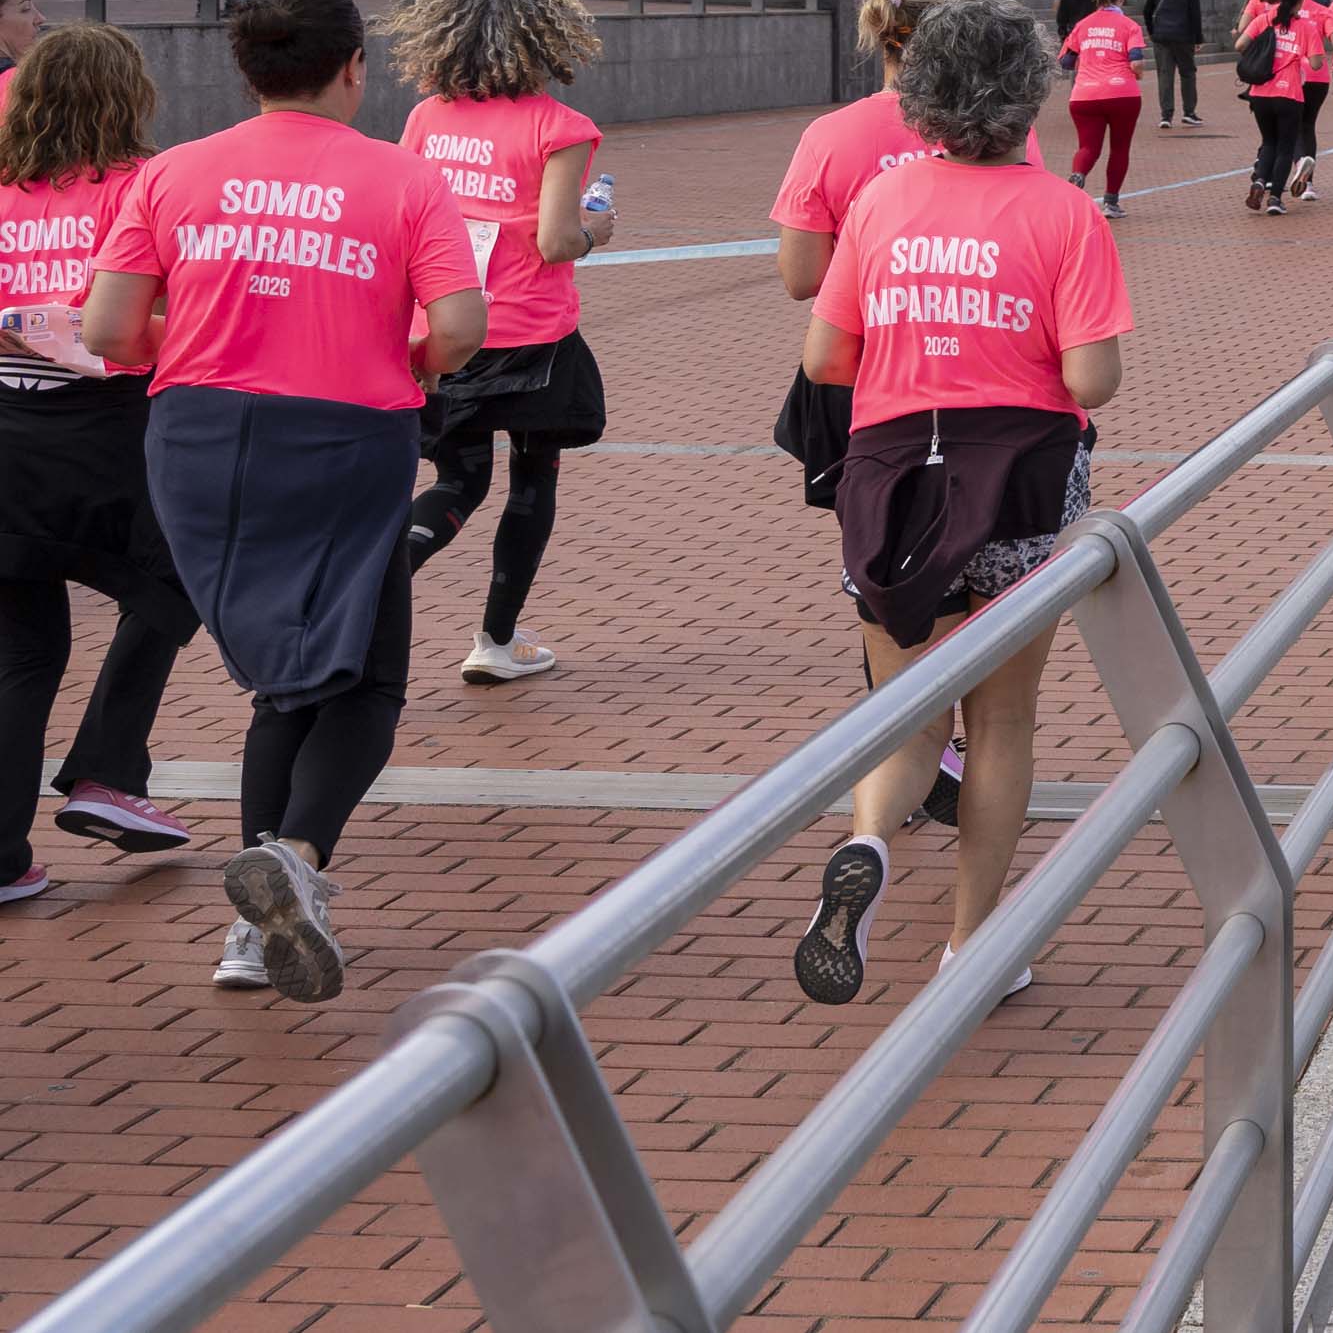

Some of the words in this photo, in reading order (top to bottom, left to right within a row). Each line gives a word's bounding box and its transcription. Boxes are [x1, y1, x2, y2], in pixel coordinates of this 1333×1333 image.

[1087, 27, 1116, 38] SOMOS
[424, 133, 494, 166] SOMOS
[219, 178, 346, 223] SOMOS
[0, 214, 96, 254] SOMOS
[175, 223, 378, 281] IMPARABLES
[890, 235, 1000, 279] SOMOS
[248, 273, 291, 298] 2026
[924, 335, 960, 357] 2026
